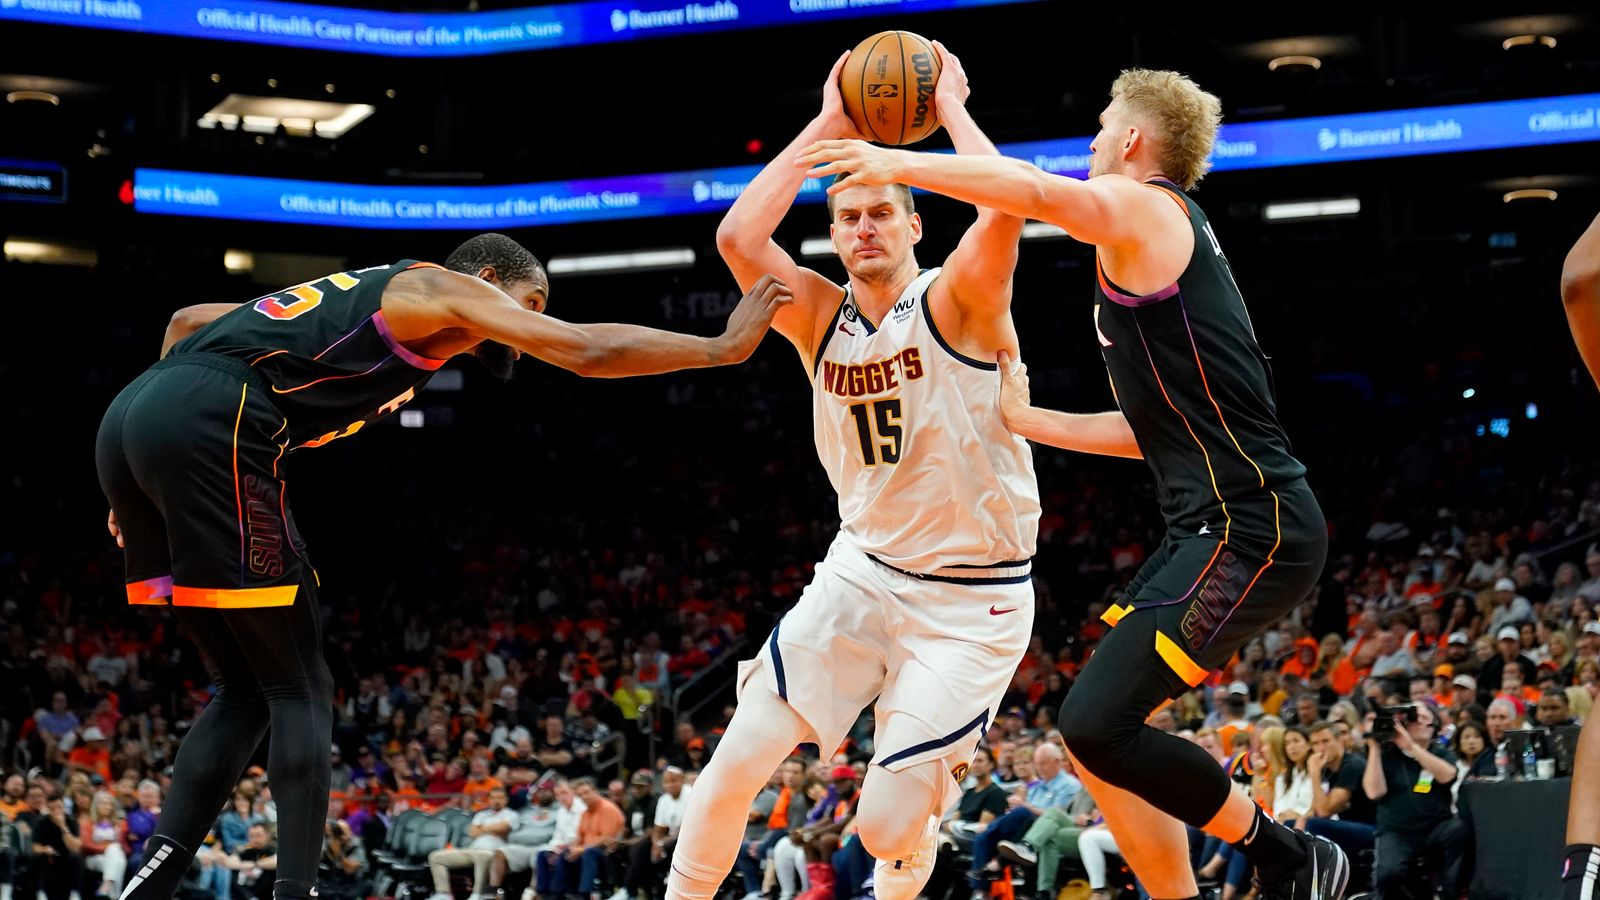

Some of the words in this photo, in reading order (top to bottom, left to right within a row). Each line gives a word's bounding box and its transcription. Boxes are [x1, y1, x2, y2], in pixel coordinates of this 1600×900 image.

[84, 0, 142, 20] Health
[629, 9, 684, 29] Banner
[685, 0, 739, 24] Health
[197, 7, 258, 32] Official
[259, 13, 314, 37] Health
[314, 19, 353, 41] Care
[355, 22, 414, 46] Partner
[415, 26, 434, 46] of
[435, 26, 461, 46] the
[464, 23, 524, 46] Phoenix
[525, 20, 563, 39] Suns
[911, 52, 935, 129] Wilson
[1339, 125, 1400, 148] Banner
[1403, 118, 1462, 144] Health
[1528, 107, 1595, 133] Official
[164, 184, 219, 207] Health
[280, 193, 339, 215] Official
[340, 197, 394, 218] Health
[395, 199, 434, 218] Care
[435, 199, 494, 219] Partner
[495, 198, 513, 218] of
[513, 197, 540, 217] the
[540, 193, 600, 214] Phoenix
[600, 190, 640, 209] Suns
[893, 308, 914, 321] Western
[894, 297, 915, 314] WU
[896, 314, 911, 325] Union
[823, 347, 924, 398] NUGGETS
[850, 398, 903, 467] 15
[243, 474, 283, 577] SUNS
[1180, 551, 1249, 651] SUNS
